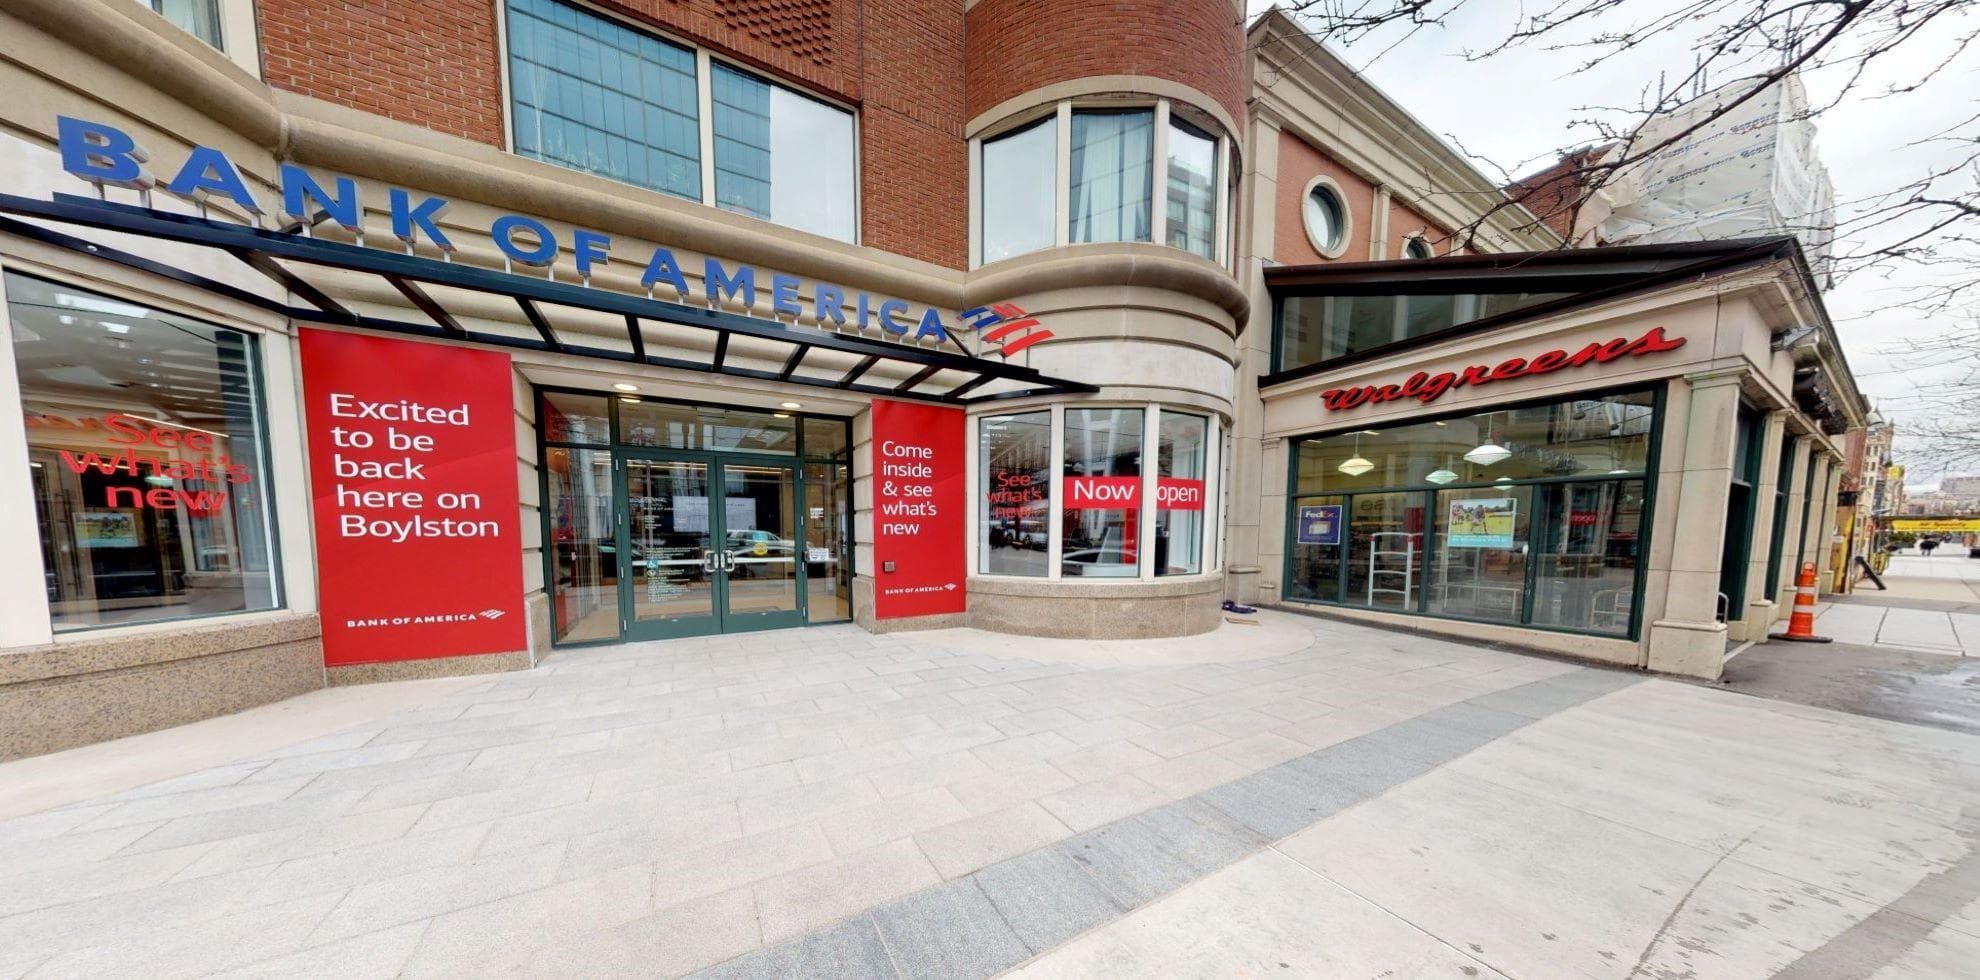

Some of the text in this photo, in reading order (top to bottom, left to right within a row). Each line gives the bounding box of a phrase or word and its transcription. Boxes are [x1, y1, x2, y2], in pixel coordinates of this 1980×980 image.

[57, 115, 948, 343] BANK OF AMERICA
[1320, 326, 1687, 412] Walgreens
[329, 393, 470, 426] Excited
[102, 412, 214, 452] See
[330, 427, 434, 452] to be
[882, 440, 933, 460] Come
[59, 447, 252, 484] what's
[334, 454, 426, 480] back
[882, 461, 933, 479] inside
[882, 481, 933, 498] & see
[997, 470, 1031, 487] See
[104, 485, 229, 514] new
[337, 484, 481, 510] here on
[1073, 479, 1199, 507] Now open
[882, 500, 938, 517] what's
[1305, 510, 1335, 518] FedEx
[340, 514, 500, 543] Boylston
[882, 521, 920, 536] new
[914, 585, 944, 593] AMERICA
[346, 612, 477, 628] BANK OF AMERICA
